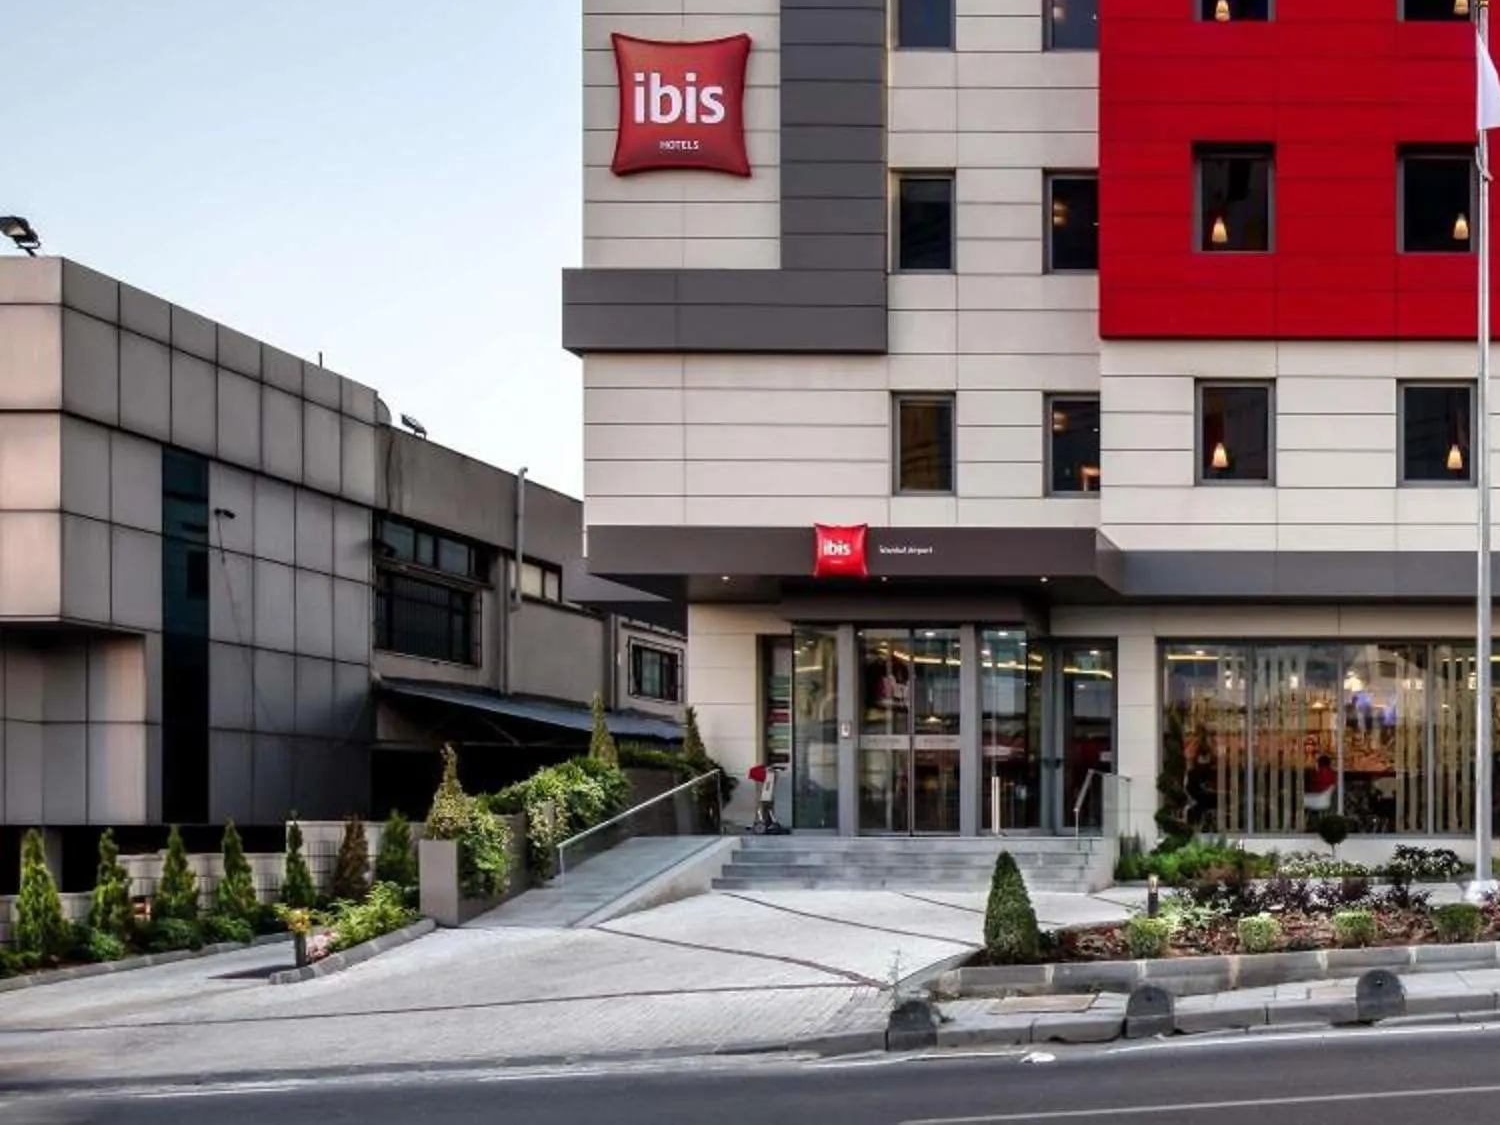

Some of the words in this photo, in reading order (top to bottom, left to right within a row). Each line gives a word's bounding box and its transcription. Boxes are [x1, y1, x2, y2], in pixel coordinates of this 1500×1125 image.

[634, 72, 725, 124] ibis
[659, 140, 699, 150] HOTELS
[823, 539, 851, 556] ibis
